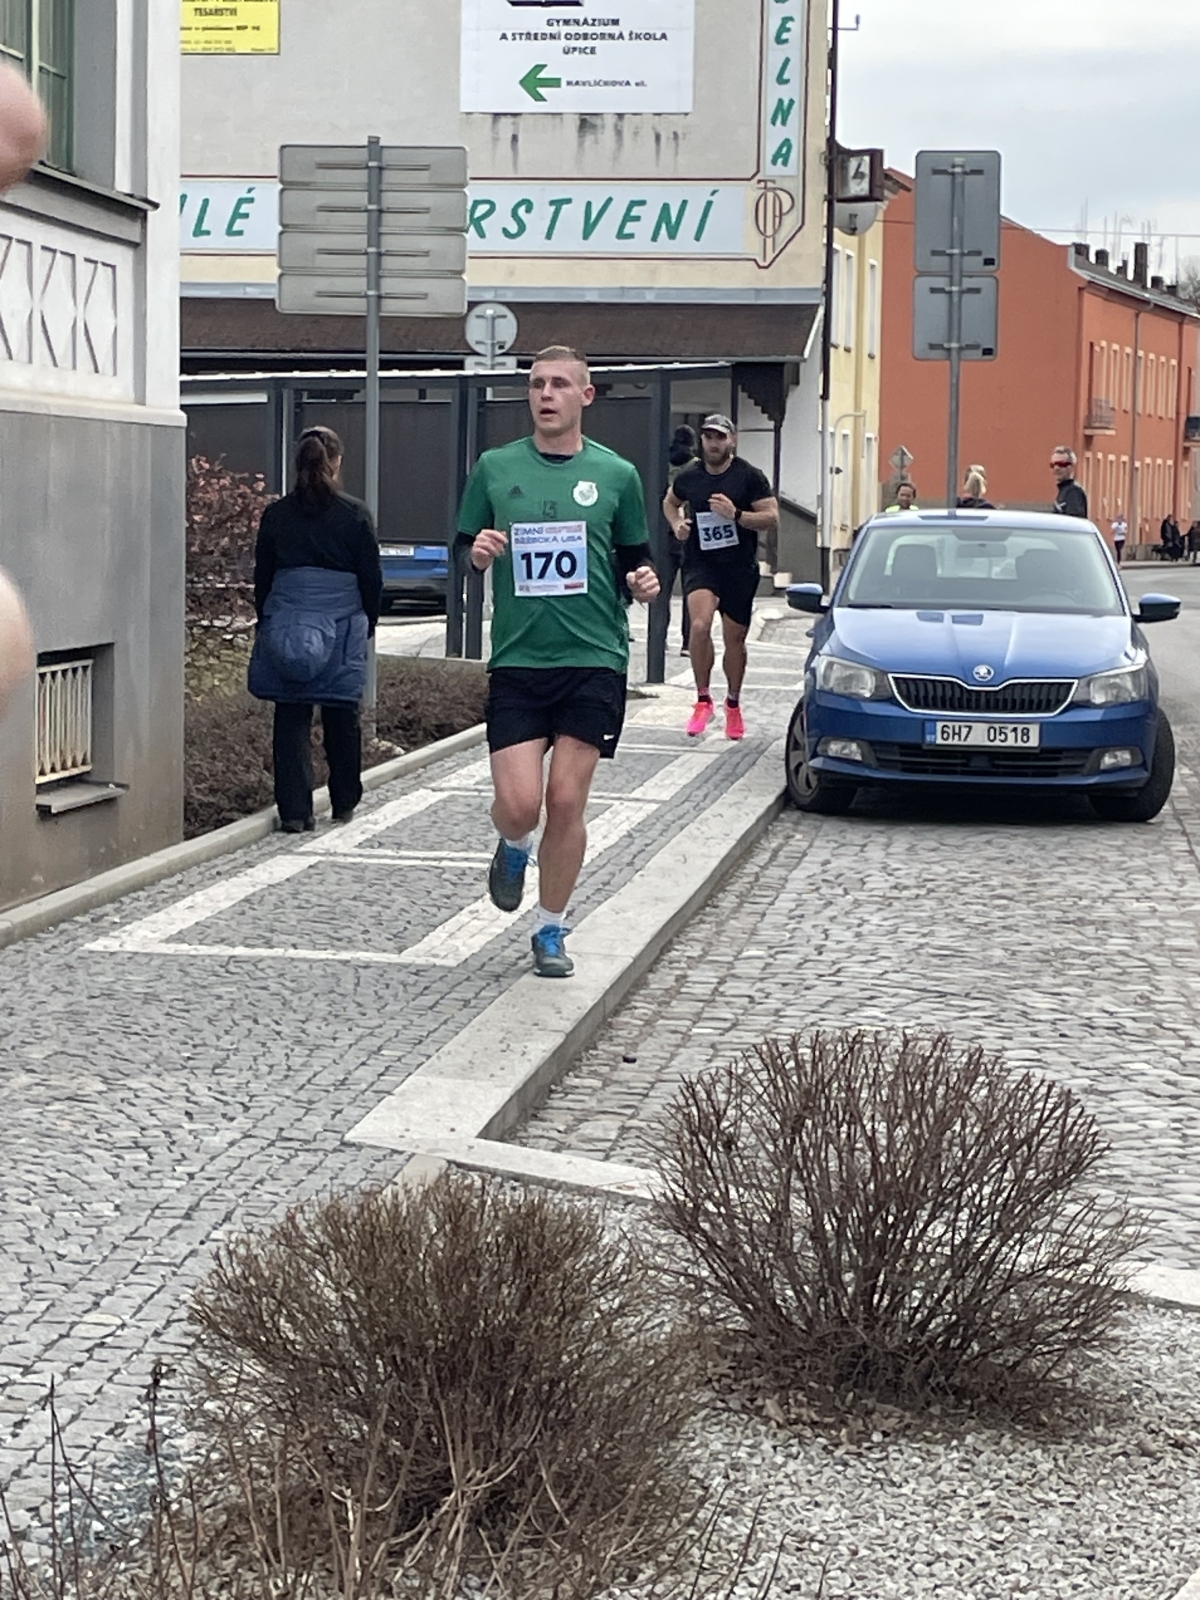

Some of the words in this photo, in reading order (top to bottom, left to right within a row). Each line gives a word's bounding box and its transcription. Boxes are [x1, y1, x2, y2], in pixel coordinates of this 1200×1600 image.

[546, 15, 620, 27] GYMNÁZIUM
[499, 32, 509, 41] A
[511, 30, 561, 41] STŘEDNÍ
[564, 31, 625, 41] ODBORNÁ
[628, 30, 668, 41] ŠKOLA
[562, 44, 597, 55] ÚPICE
[770, 0, 795, 168] ELNA
[702, 524, 734, 542] 365
[521, 550, 577, 580] 170
[941, 724, 973, 742] 6H7
[987, 726, 1030, 744] 0518
